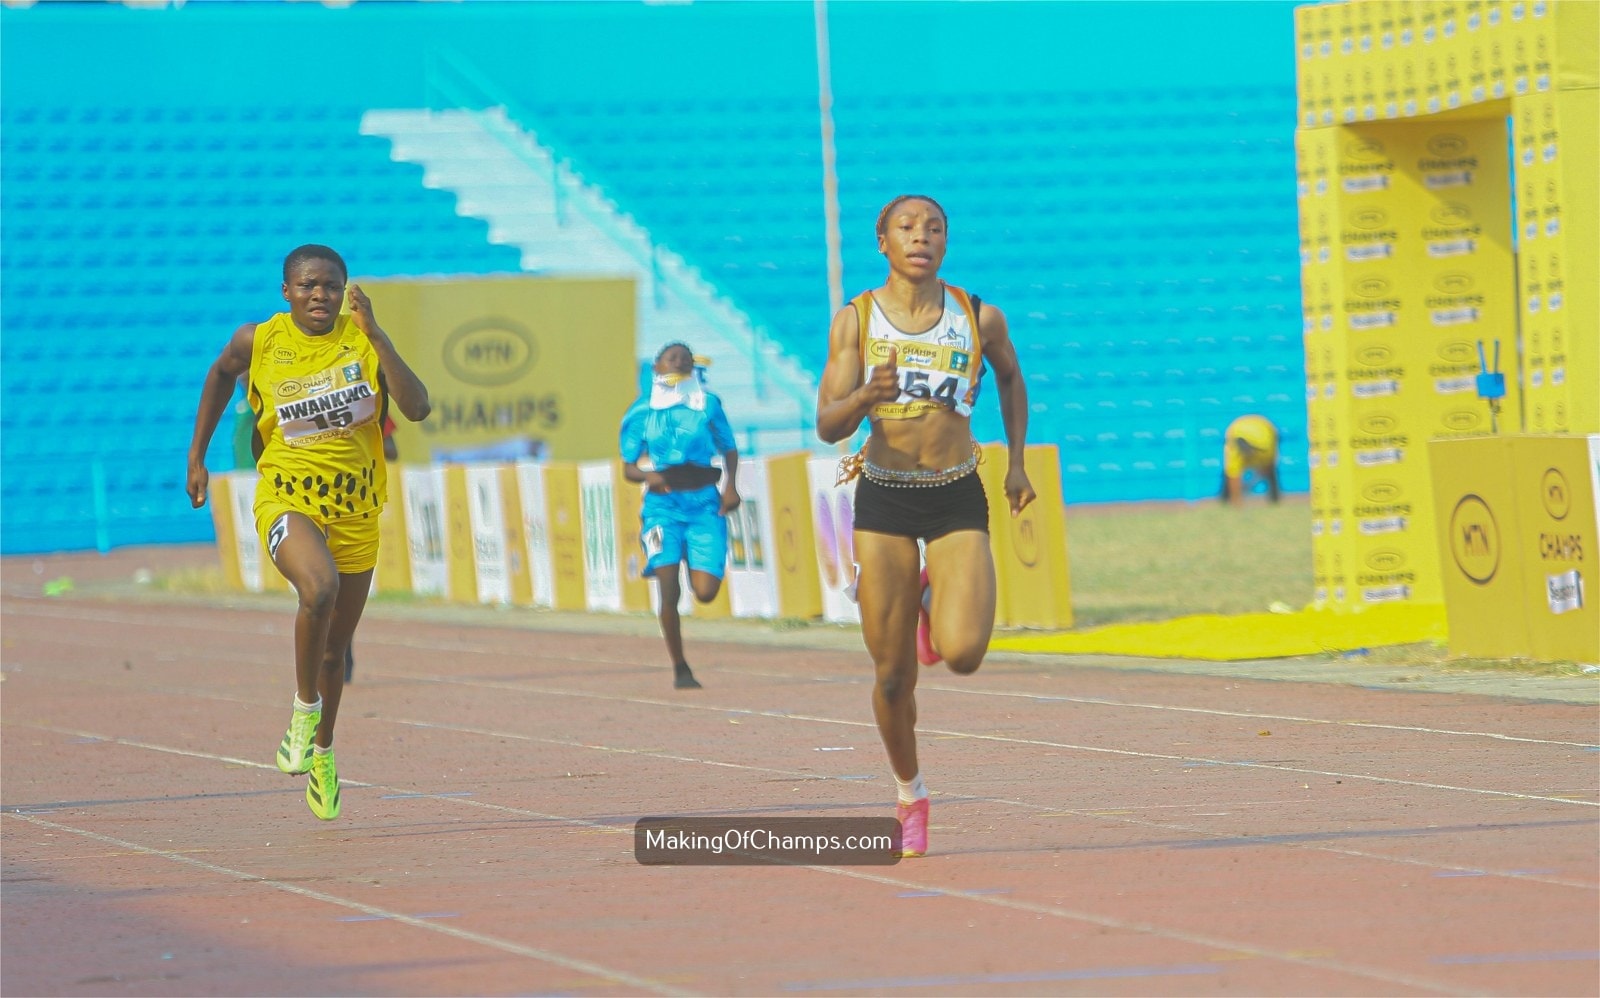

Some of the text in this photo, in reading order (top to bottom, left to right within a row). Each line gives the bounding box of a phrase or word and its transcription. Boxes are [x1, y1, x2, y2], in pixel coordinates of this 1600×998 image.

[902, 347, 937, 358] CHAMPS
[279, 386, 371, 420] NWANKWO
[897, 371, 958, 410] 54
[307, 406, 353, 430] 15
